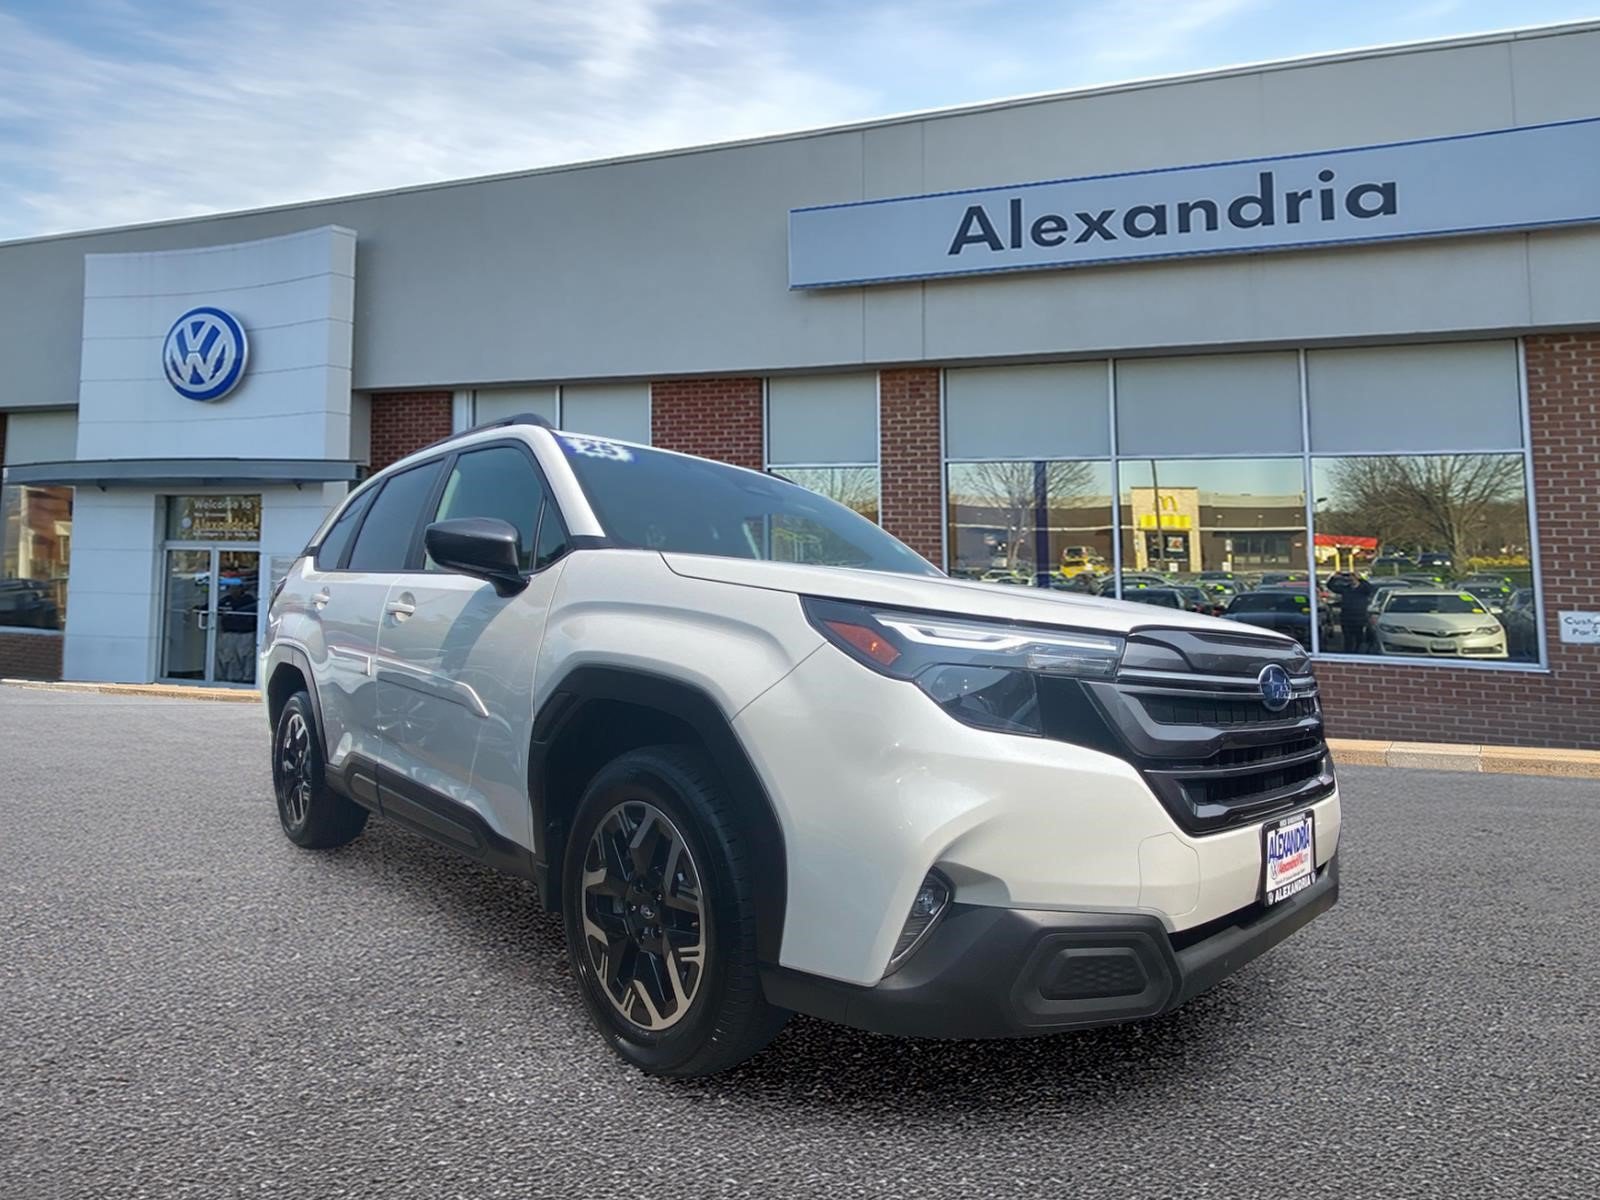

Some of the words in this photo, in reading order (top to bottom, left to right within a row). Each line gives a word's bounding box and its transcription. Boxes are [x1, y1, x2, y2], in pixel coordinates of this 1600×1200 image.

[948, 169, 1398, 255] Alexandria
[194, 499, 239, 509] Welcome
[241, 500, 253, 509] to
[193, 517, 254, 530] Alexandria
[1268, 822, 1310, 863] ALEXANDRIA
[1275, 873, 1311, 903] ALEXANDRIA
